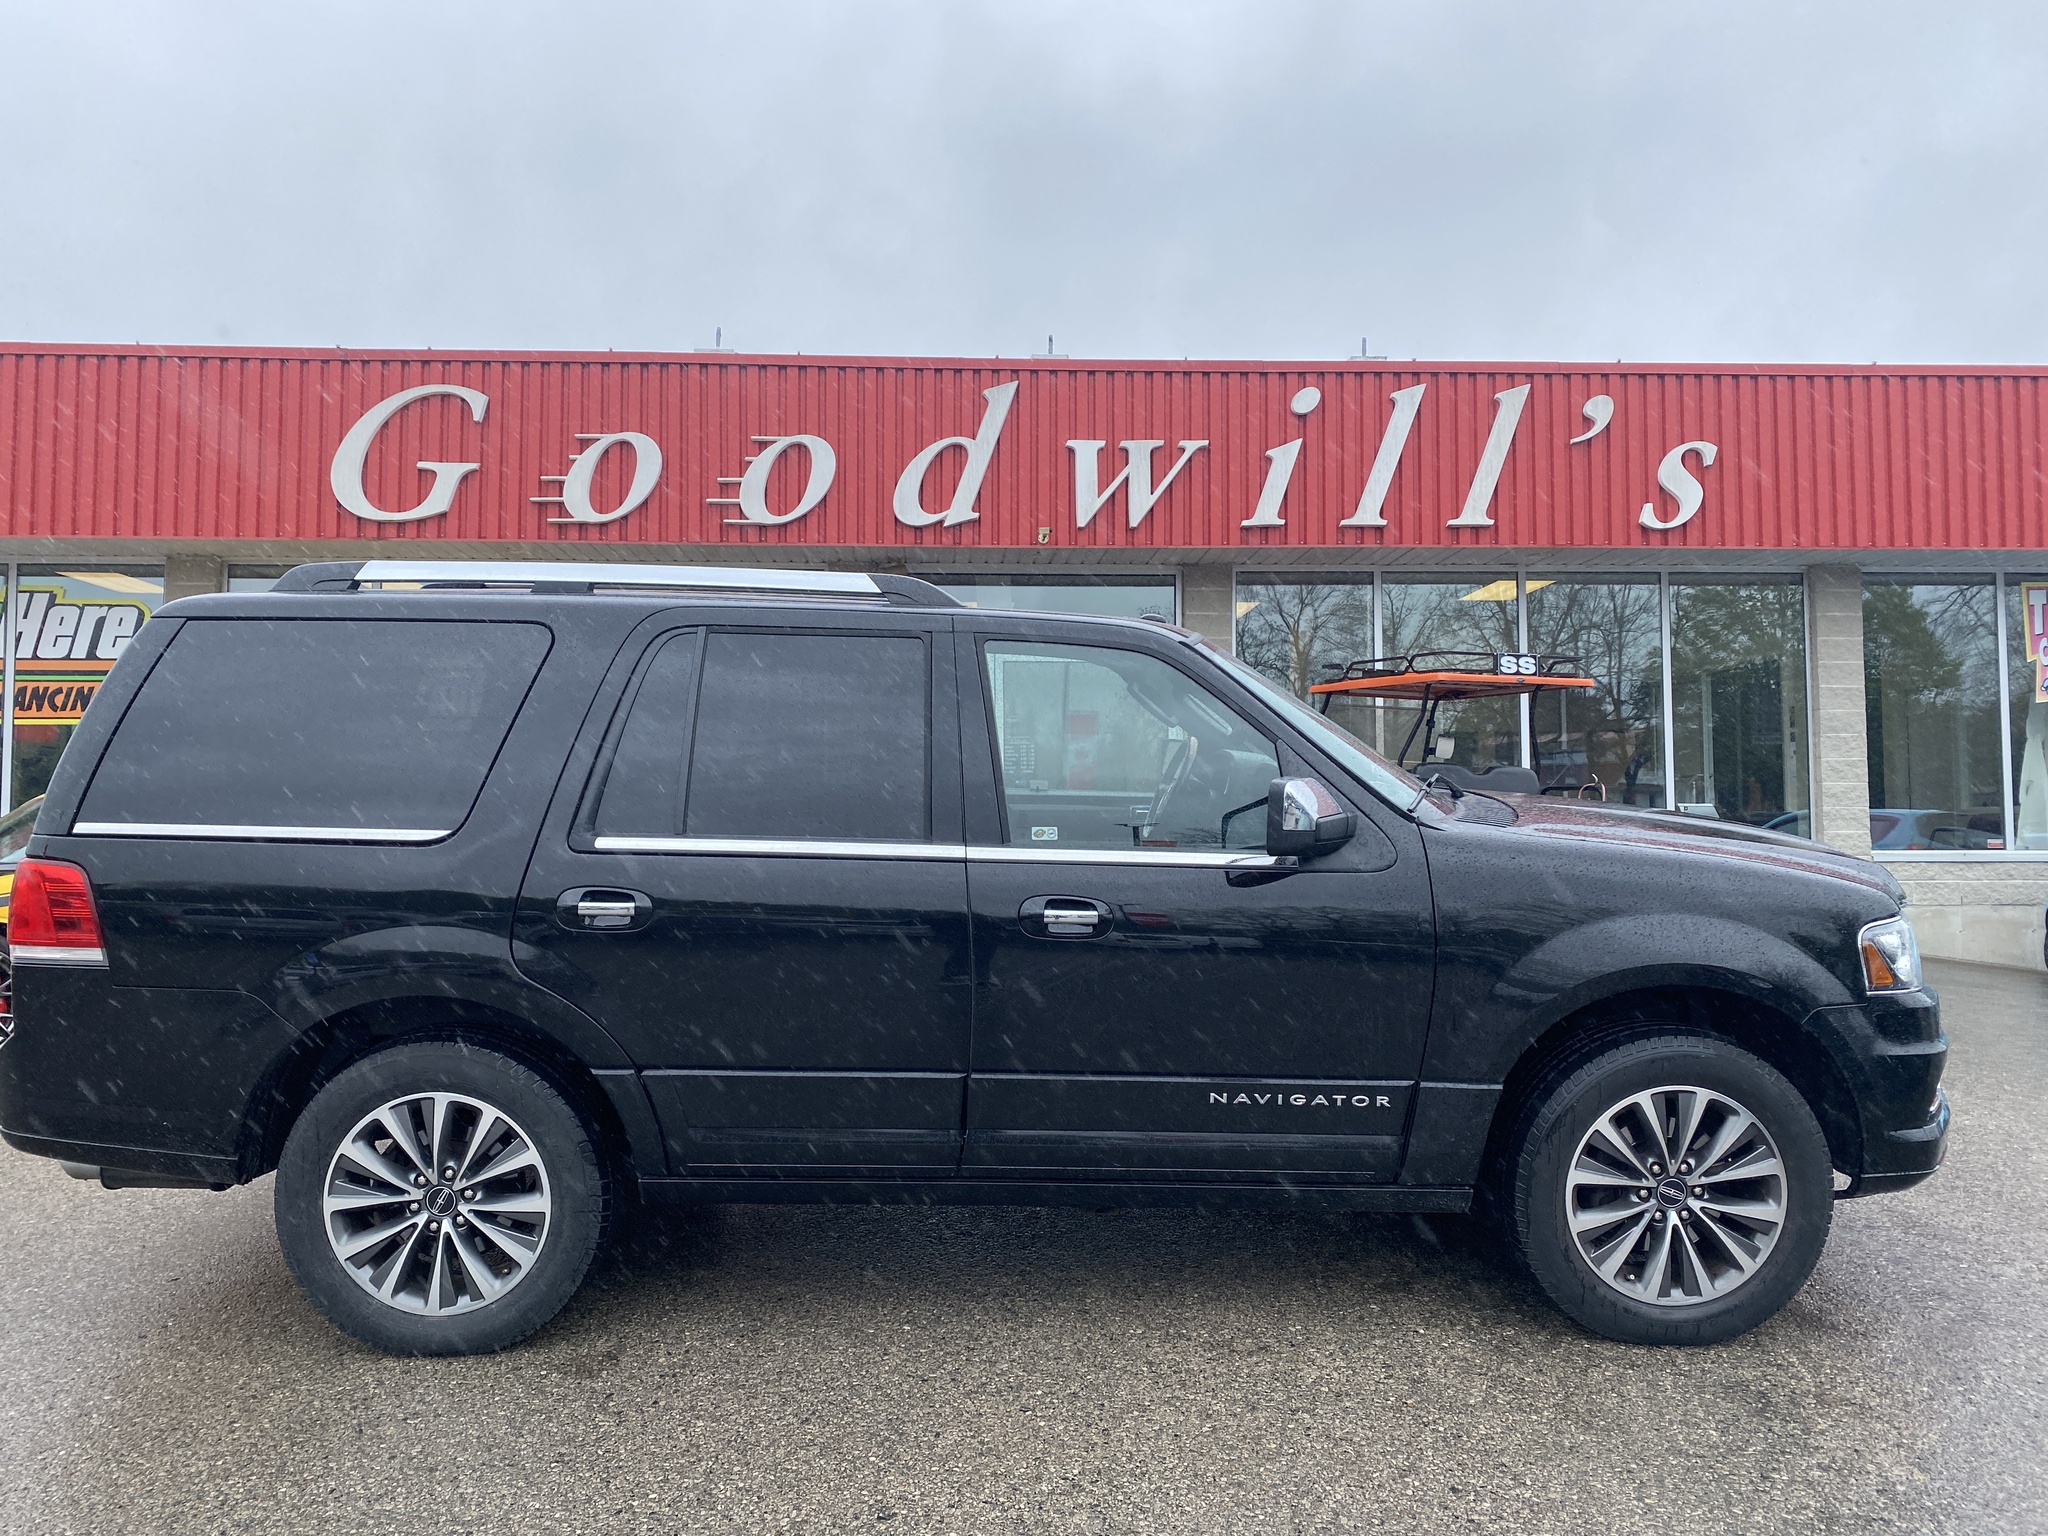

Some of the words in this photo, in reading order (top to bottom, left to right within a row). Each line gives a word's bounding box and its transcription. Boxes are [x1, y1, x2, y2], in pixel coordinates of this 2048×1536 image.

[330, 380, 1718, 530] Goodwill's
[0, 592, 139, 659] Here
[1500, 655, 1536, 675] SS
[0, 685, 95, 713] ANCIN
[1210, 1092, 1391, 1108] NAVIGATOR
